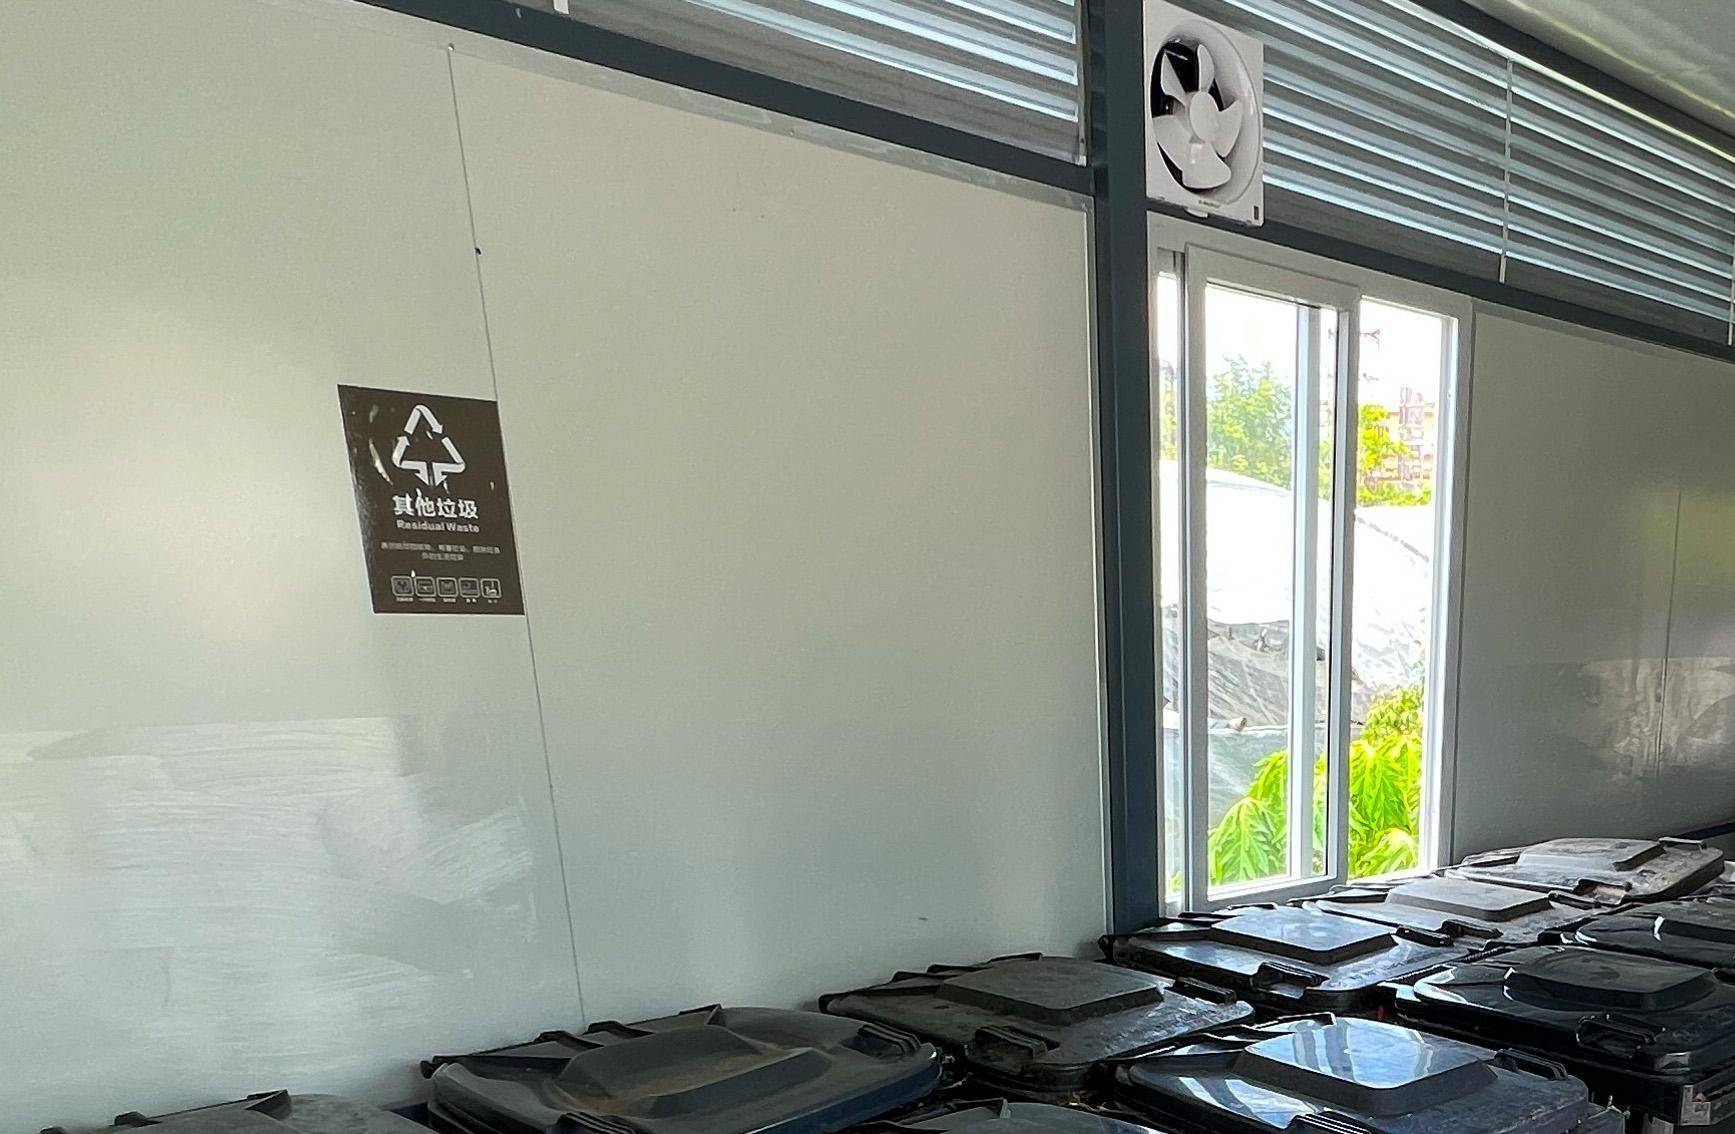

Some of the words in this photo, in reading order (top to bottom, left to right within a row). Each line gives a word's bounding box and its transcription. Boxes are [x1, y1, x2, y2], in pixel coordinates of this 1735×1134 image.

[392, 491, 479, 519] 其他垃圾
[396, 519, 445, 531] Residual
[446, 522, 480, 533] Waste
